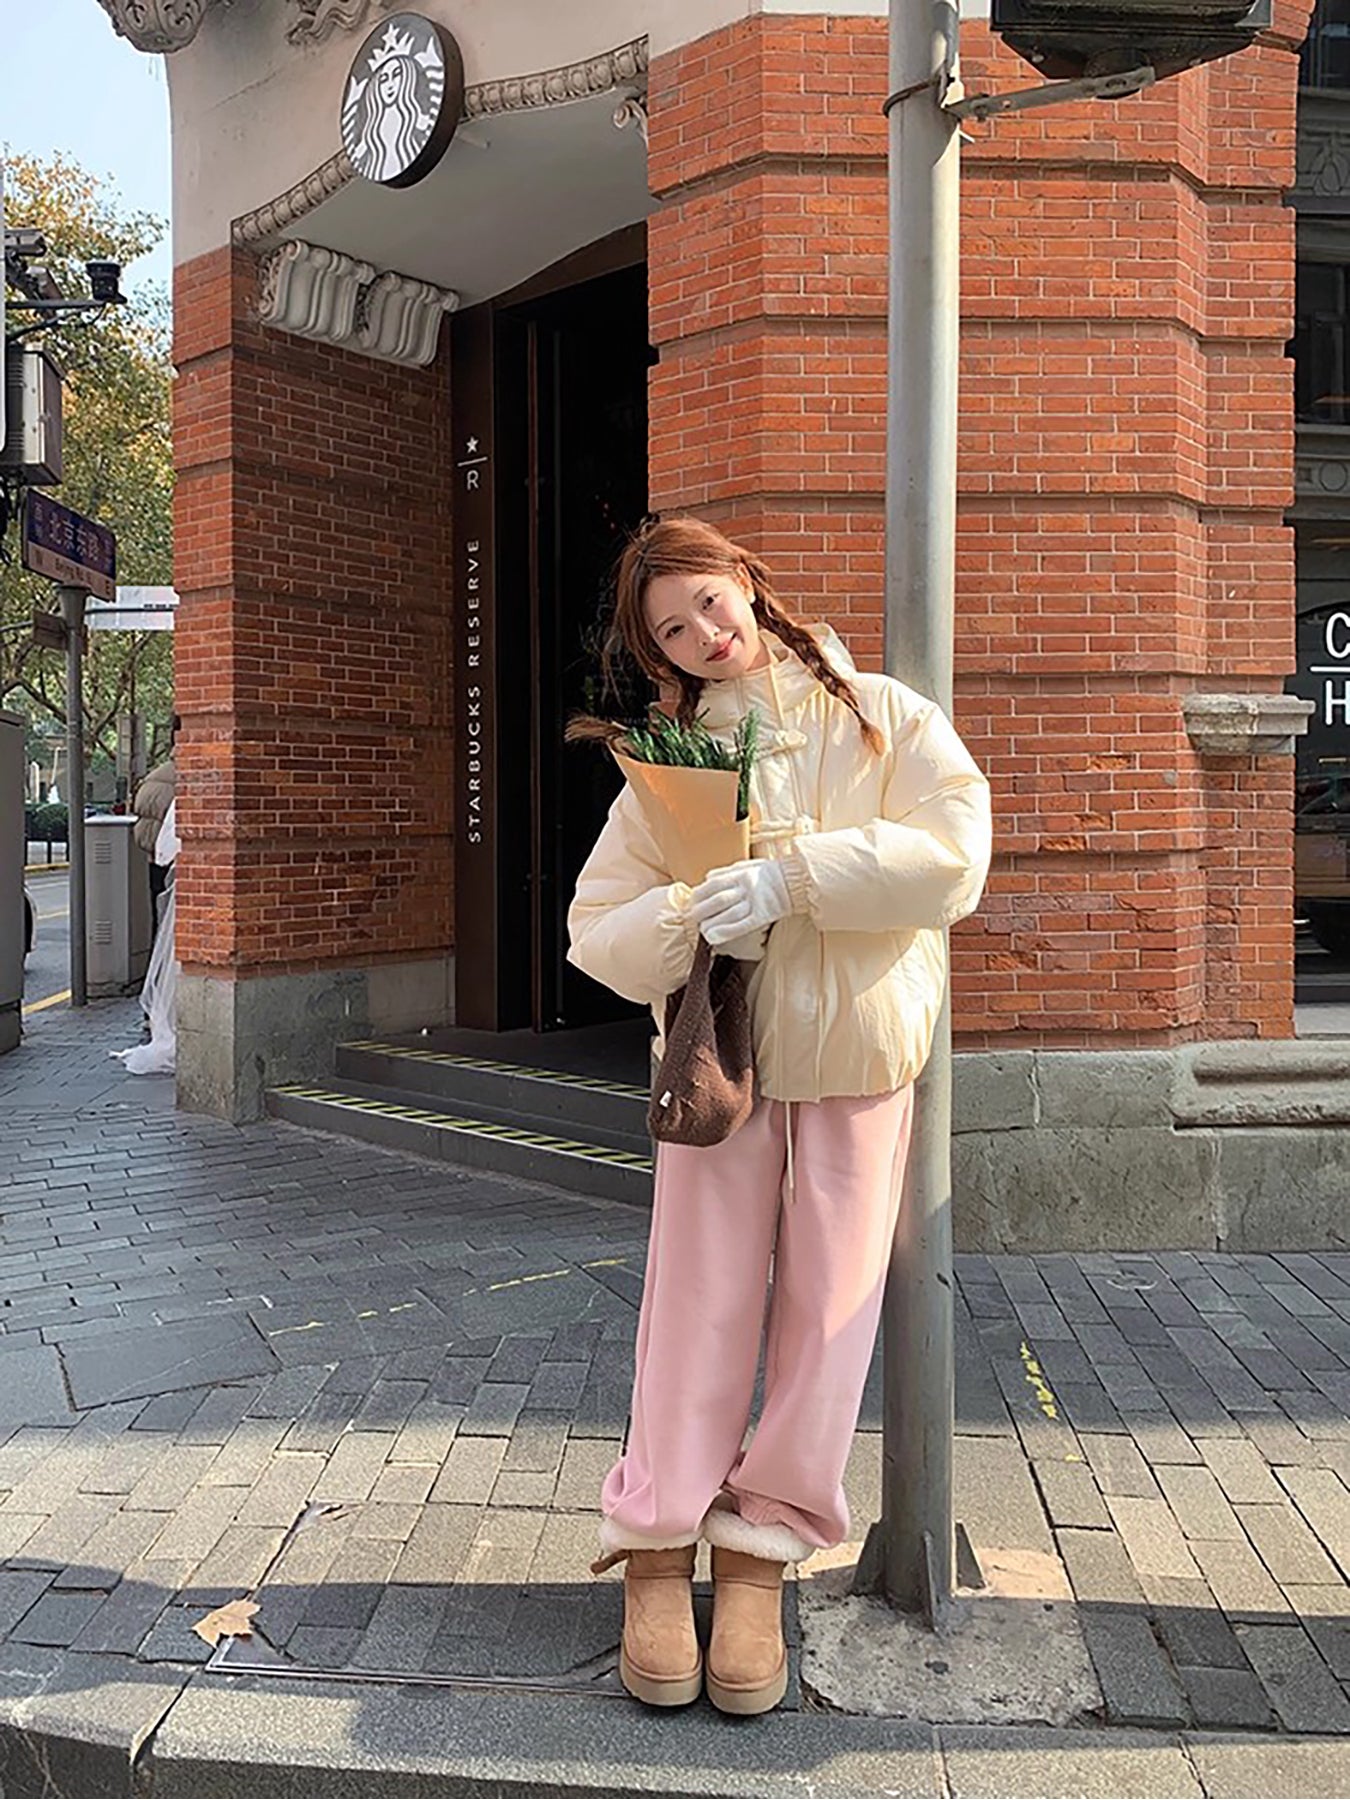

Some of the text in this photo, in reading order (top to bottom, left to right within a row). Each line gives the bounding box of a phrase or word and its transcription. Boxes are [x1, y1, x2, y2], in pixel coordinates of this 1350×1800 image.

[466, 469, 480, 491] R
[466, 539, 482, 844] STARBUCKS RESERVE
[1325, 679, 1350, 726] H
